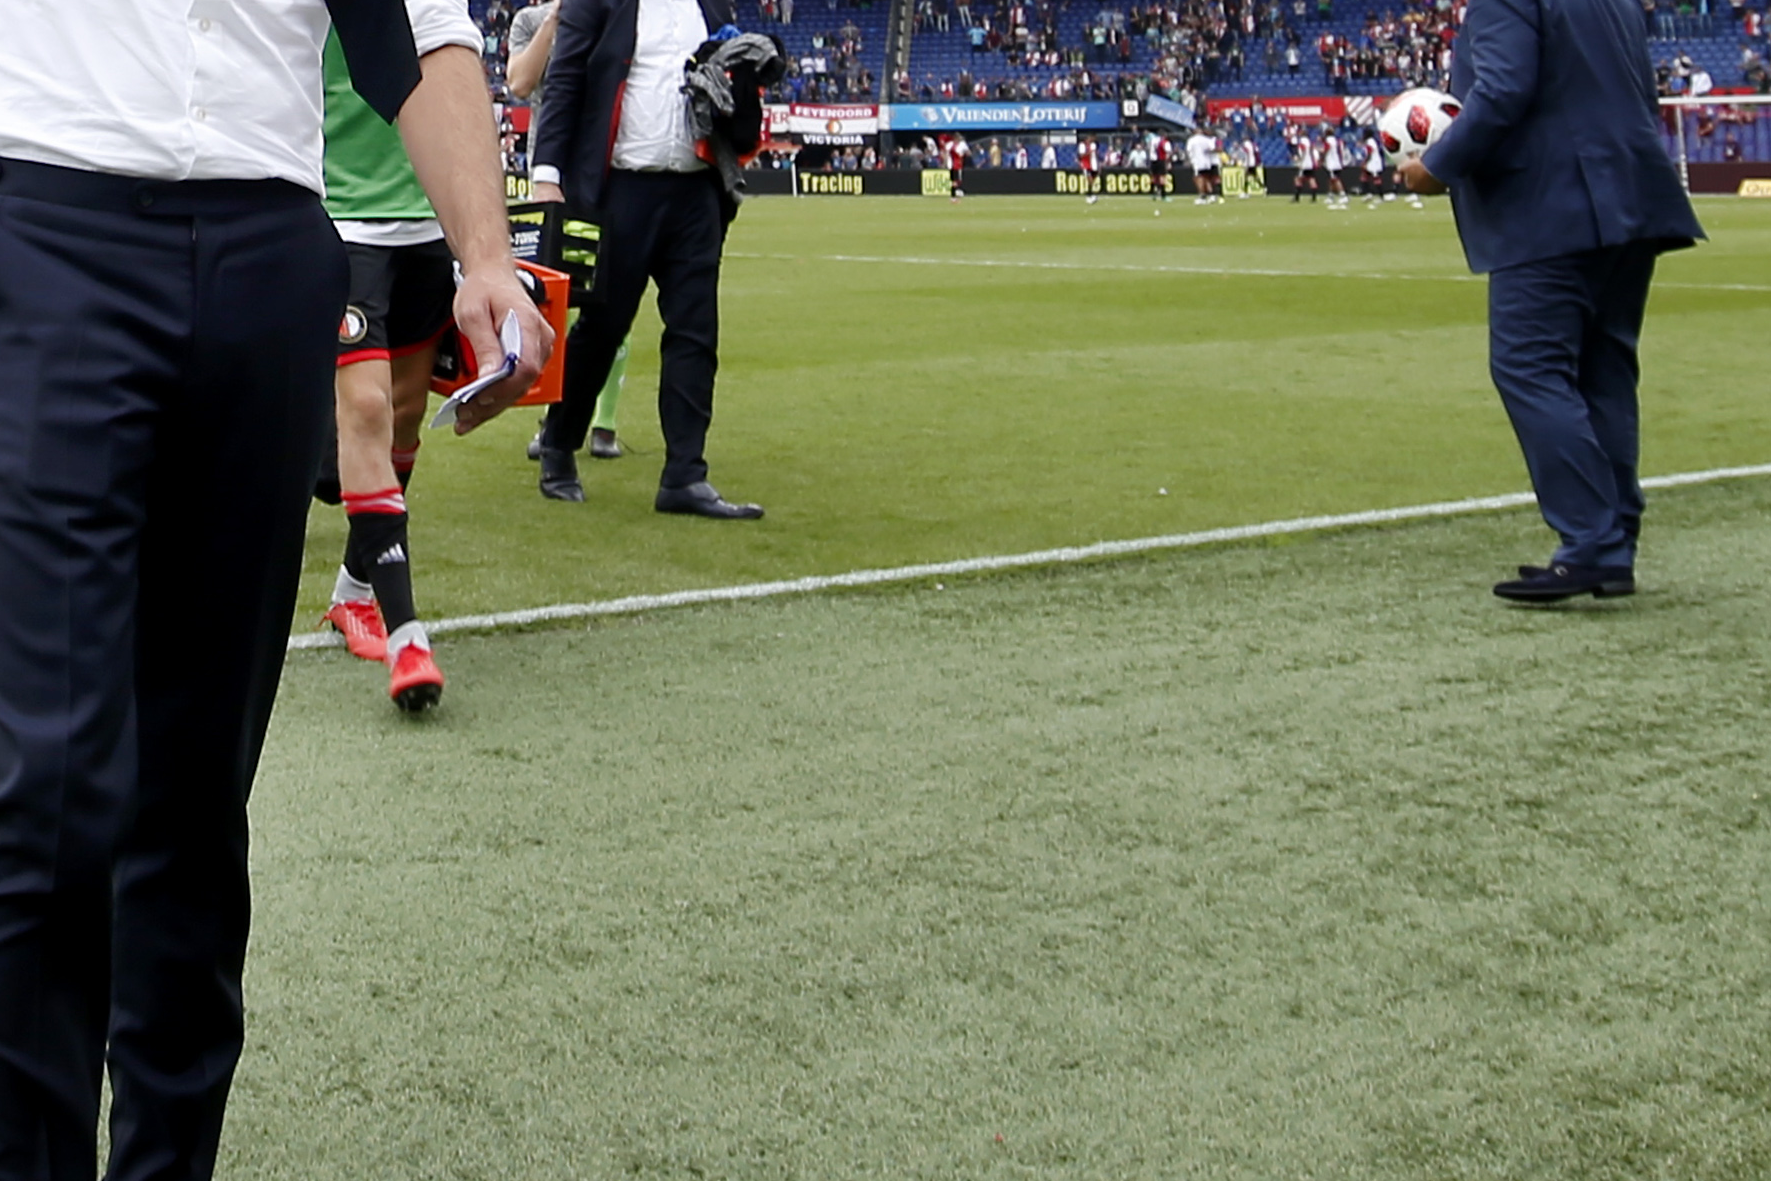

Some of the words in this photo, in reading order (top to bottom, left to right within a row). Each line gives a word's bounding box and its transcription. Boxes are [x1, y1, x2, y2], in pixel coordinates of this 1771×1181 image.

[794, 105, 873, 119] FEYENOORD
[802, 134, 864, 145] VICTORIA
[800, 172, 864, 195] Tracing
[1106, 172, 1174, 194] acces
